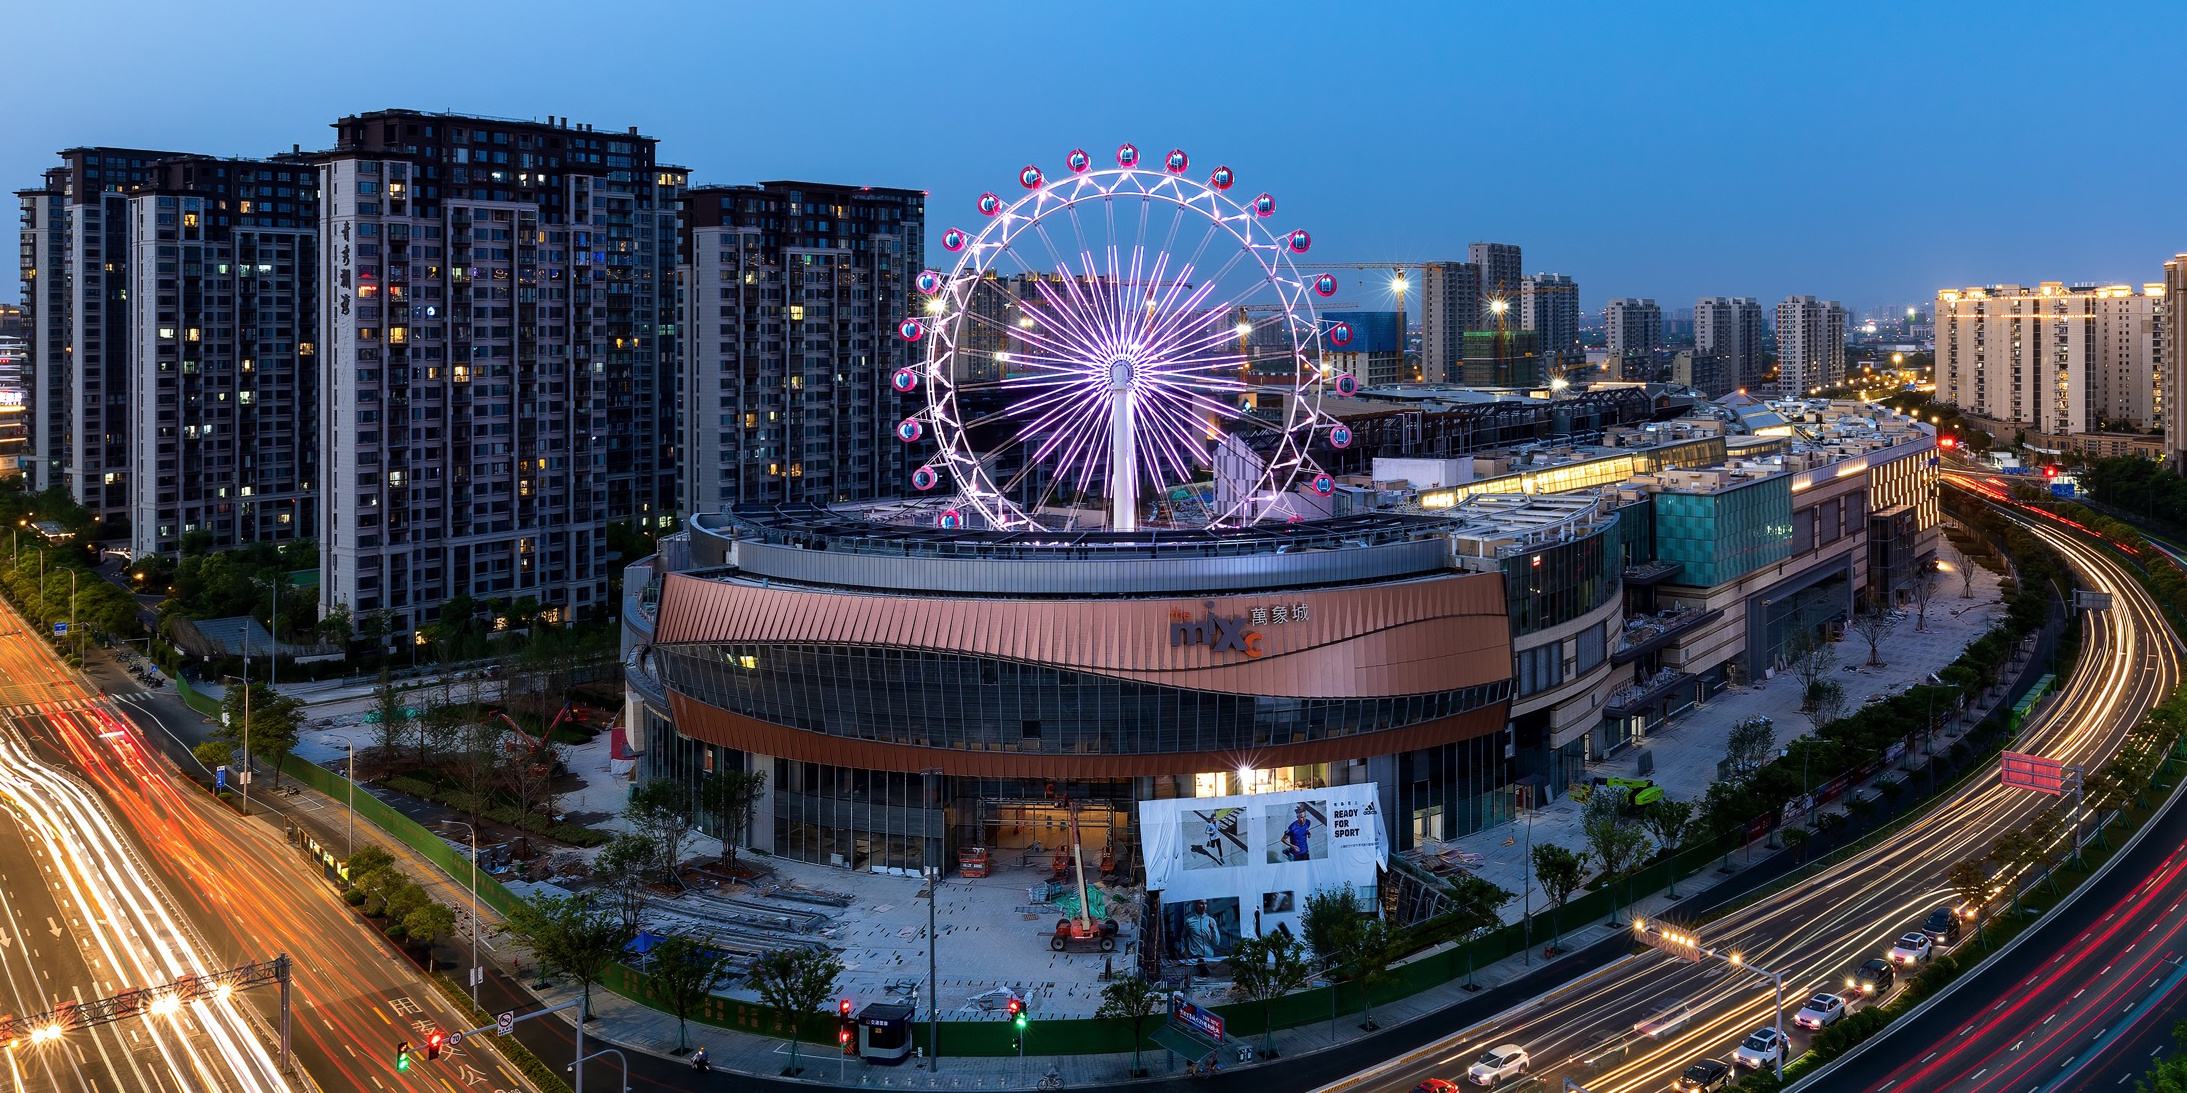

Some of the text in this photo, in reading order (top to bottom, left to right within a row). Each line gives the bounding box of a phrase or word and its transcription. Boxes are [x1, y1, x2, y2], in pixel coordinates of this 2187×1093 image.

[1170, 606, 1191, 620] the
[1250, 603, 1310, 627] 萬象城
[1334, 809, 1358, 818] READY
[1334, 820, 1349, 828] FOR
[1334, 828, 1359, 838] SPORT
